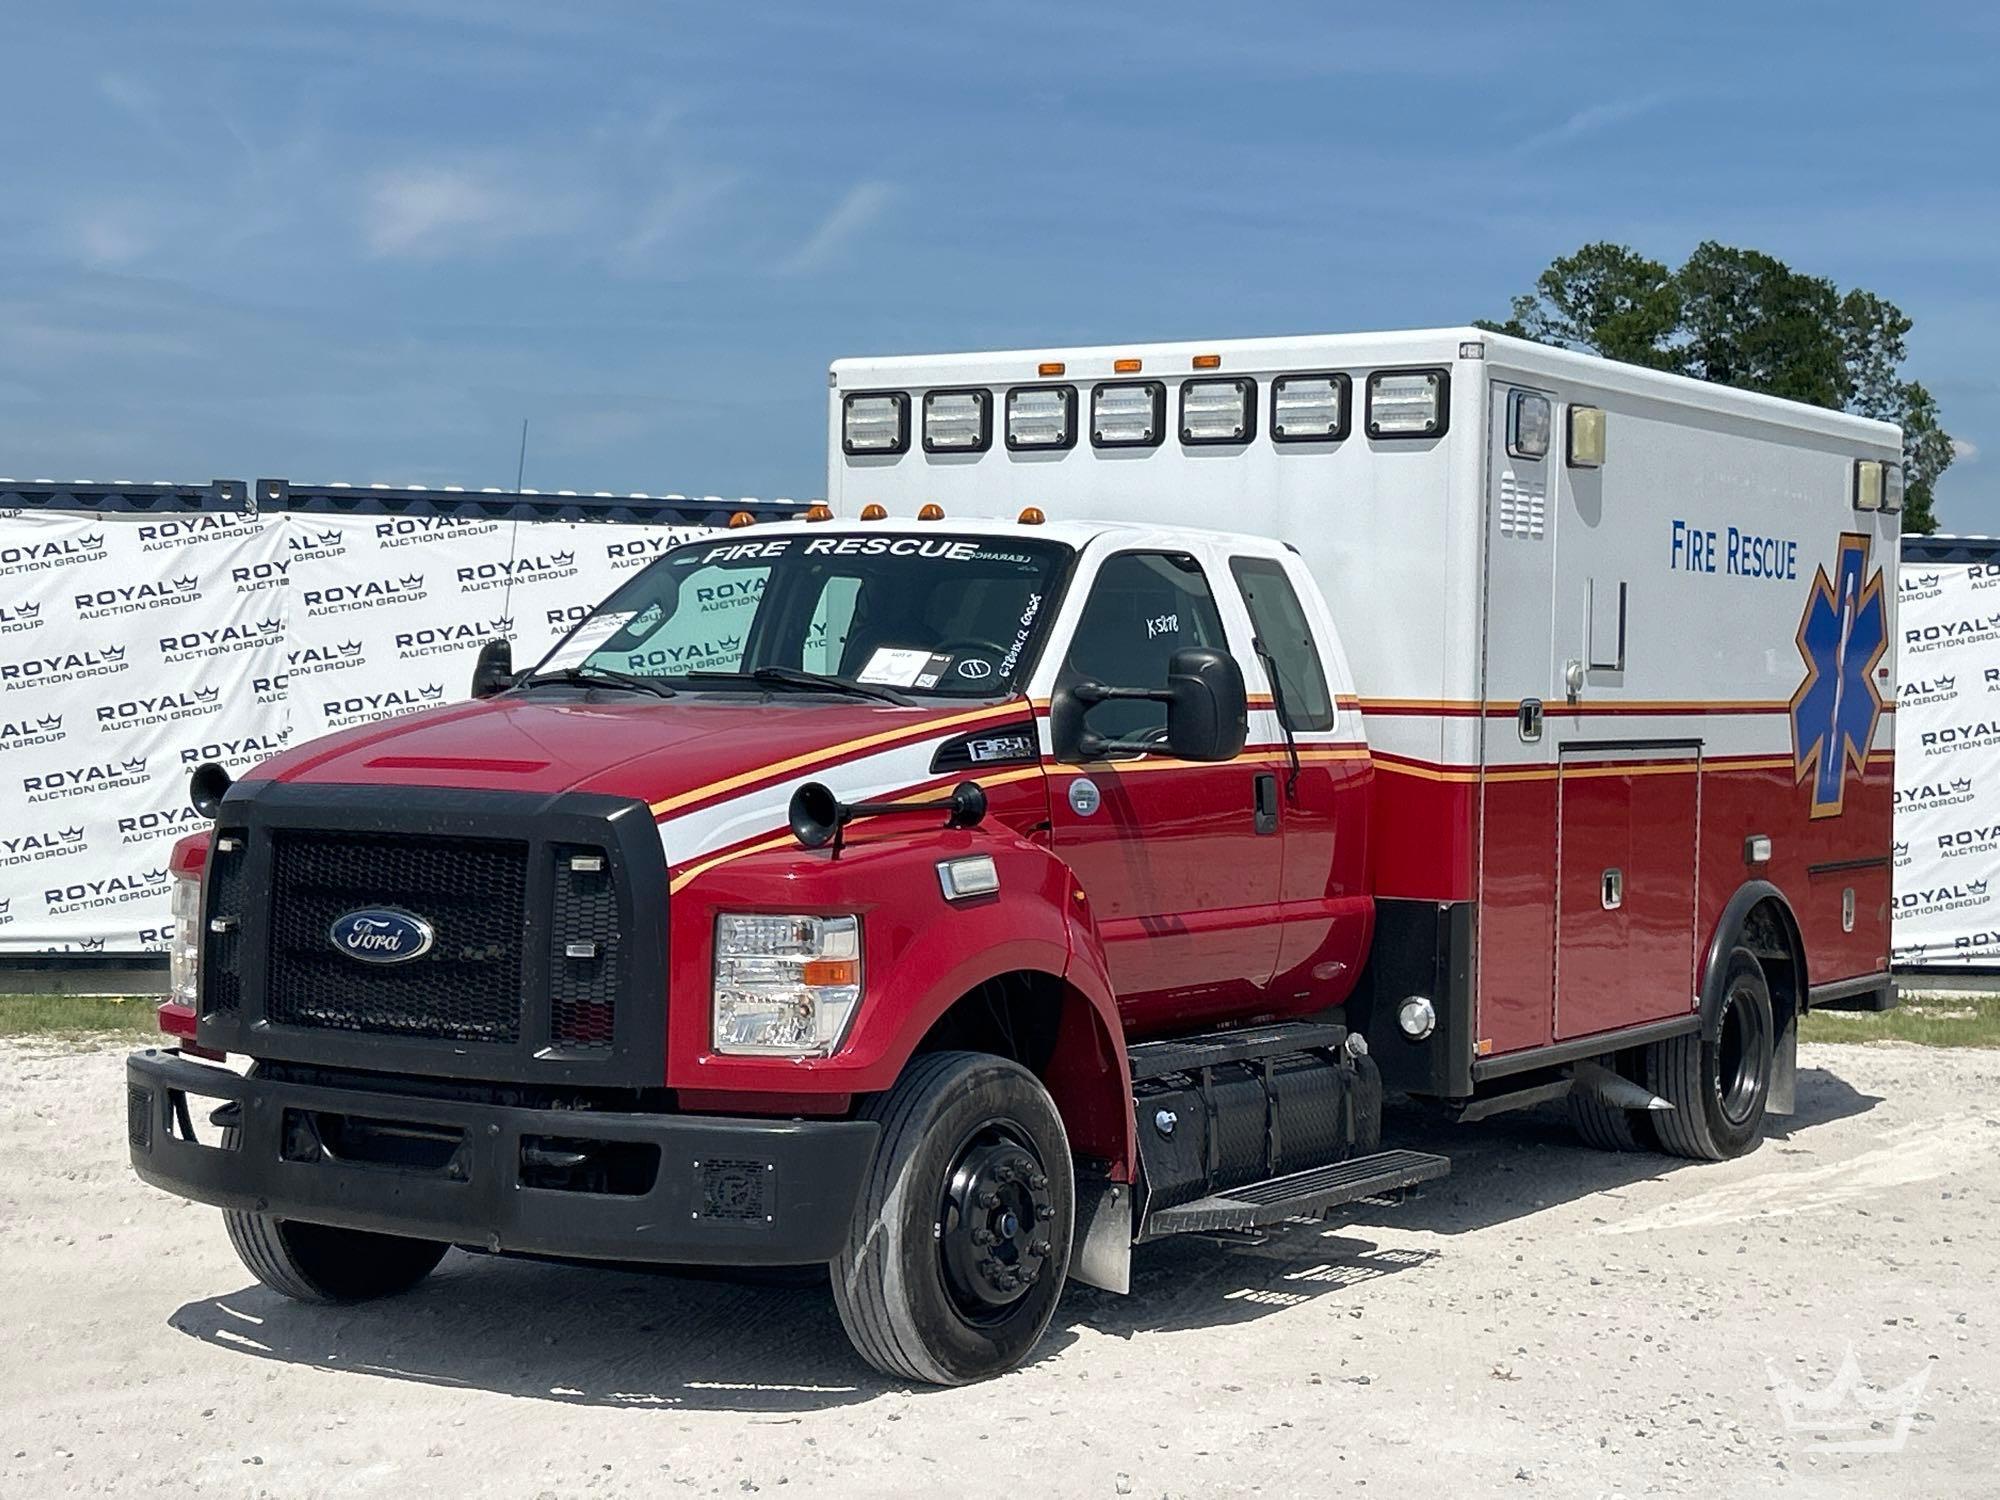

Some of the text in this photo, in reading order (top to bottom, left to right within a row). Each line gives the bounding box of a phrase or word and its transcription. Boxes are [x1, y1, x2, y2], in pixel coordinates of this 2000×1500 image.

[138, 514, 236, 541] ROYAL
[143, 525, 264, 552] AUCTION GROUP
[380, 524, 499, 550] AUCTION GROUP
[0, 540, 80, 563] OYAL
[294, 547, 346, 563] GROUP
[702, 538, 980, 564] FIRE RESCUE
[1671, 520, 1797, 580] FIRE RESCUE
[0, 551, 108, 576] CTION GROUP
[232, 559, 291, 582] ROY
[457, 557, 548, 582] ROYAL
[304, 579, 400, 606] ROYAL
[461, 568, 578, 593] AUCTION GROUP
[697, 577, 768, 602] ROYA
[75, 580, 174, 609] ROYAL
[80, 594, 202, 620] AUCTION GROUP
[307, 591, 428, 617] AUCTION GROUP
[1, 619, 45, 634] ROUP
[160, 624, 257, 652] ROYAL
[396, 622, 490, 649] ROYAL
[1905, 619, 1989, 644] ROYAL
[164, 636, 284, 664] AUCTION GROUP
[288, 646, 338, 666] YAL
[399, 642, 464, 659] AUCTION
[628, 642, 719, 669] ROYAL
[1908, 638, 1965, 654] AUCTION
[1, 652, 101, 680] ROYAL
[6, 663, 129, 691] AUCTION GROUP
[314, 658, 366, 672] GROUP
[97, 692, 195, 721] ROYAL
[323, 690, 419, 716] ROYAL
[101, 704, 223, 732] AUCTION GROUP
[328, 711, 392, 728] AUCTION
[13, 732, 66, 748] GROUP
[180, 735, 277, 764] ROYAL
[1925, 740, 1981, 756] AUCTION
[24, 764, 122, 792] ROYAL
[28, 774, 150, 803] AUCTION GROUP
[1894, 784, 1951, 804] OYAL
[1929, 793, 1974, 809] GROUP
[118, 806, 199, 833] ROYA
[2, 833, 59, 853] YAL
[122, 825, 188, 844] AUCTION
[1938, 825, 2000, 848] ROYA
[35, 843, 88, 861] GROUP
[1941, 842, 1997, 858] AUCTION
[45, 875, 143, 904] ROYAL
[49, 886, 172, 915] AUCTION GROUP
[1892, 895, 1991, 919] UCTION GROUP
[347, 918, 403, 951] Ford
